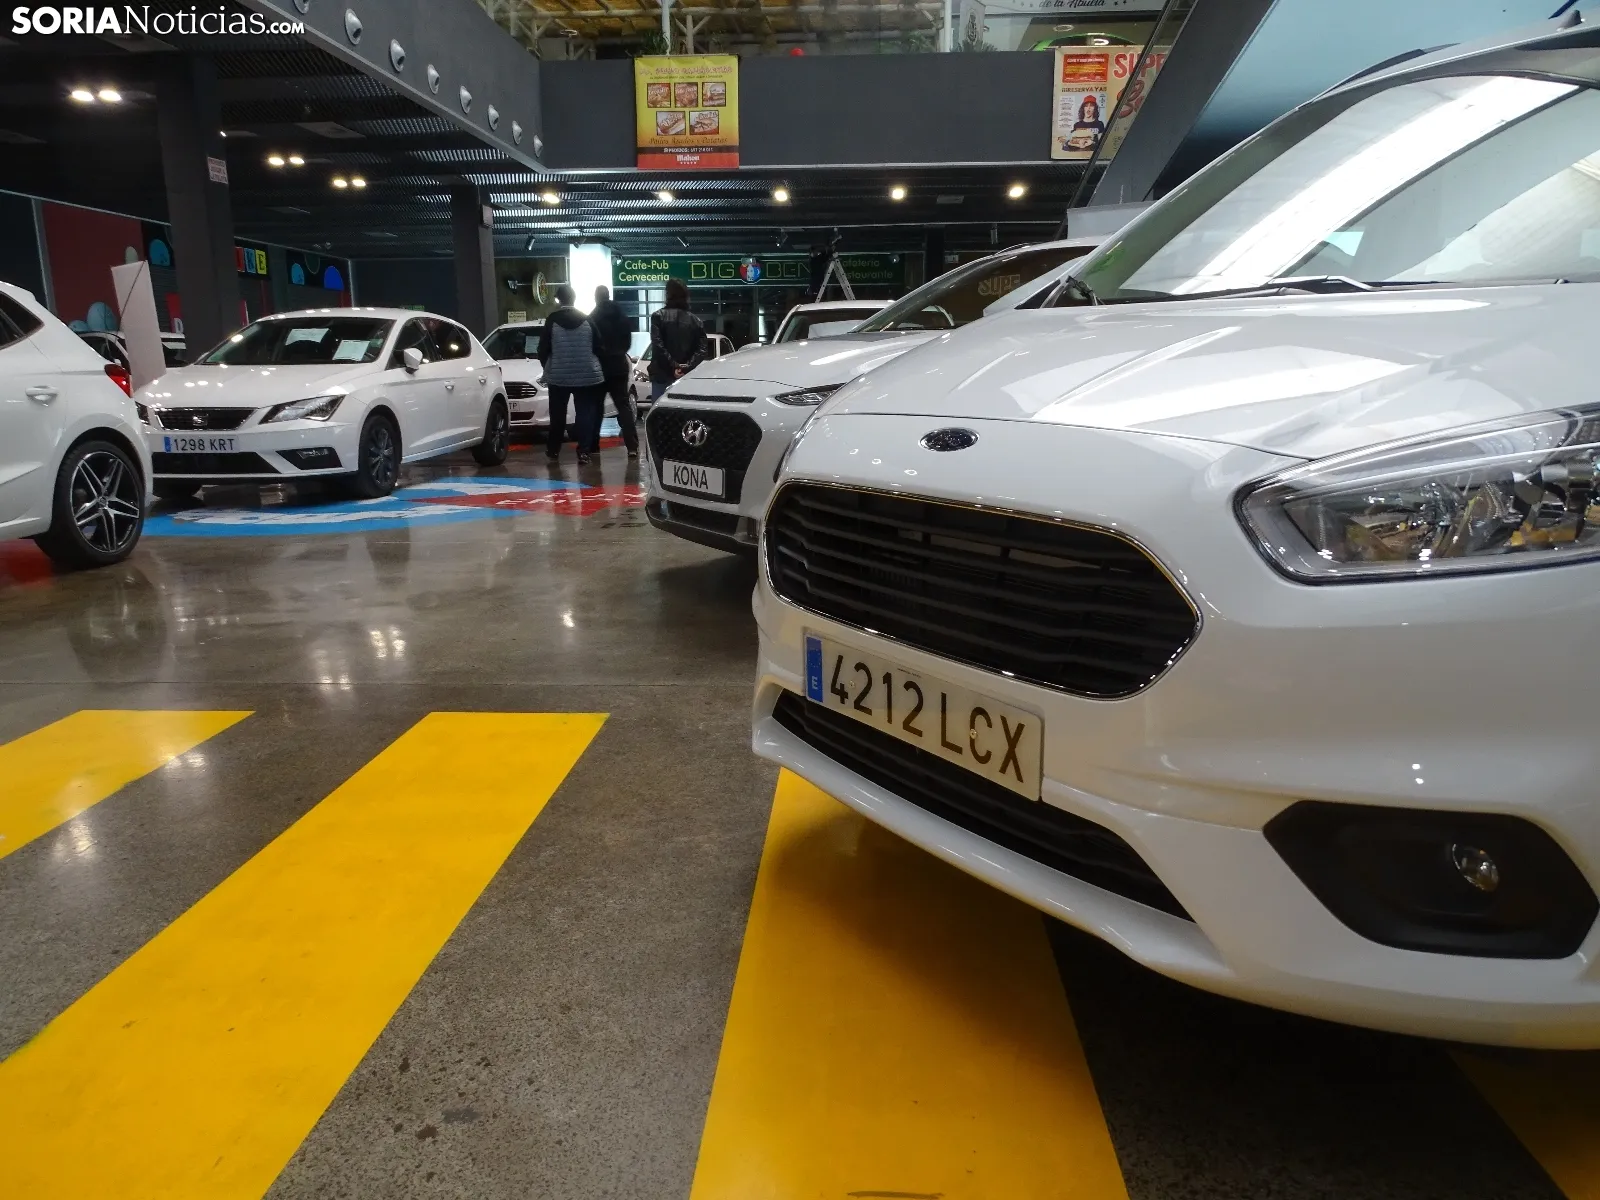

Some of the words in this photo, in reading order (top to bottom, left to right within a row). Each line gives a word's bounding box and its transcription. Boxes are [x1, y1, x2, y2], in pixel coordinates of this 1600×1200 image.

[624, 259, 669, 270] Cafe-Pub
[842, 258, 880, 267] afeteria
[691, 262, 735, 279] BIG
[846, 270, 893, 280] staurante
[173, 438, 206, 451] 1298
[209, 438, 236, 451] KRT
[673, 464, 709, 490] KONA
[830, 654, 924, 738] 4212
[940, 691, 1026, 784] LCX
